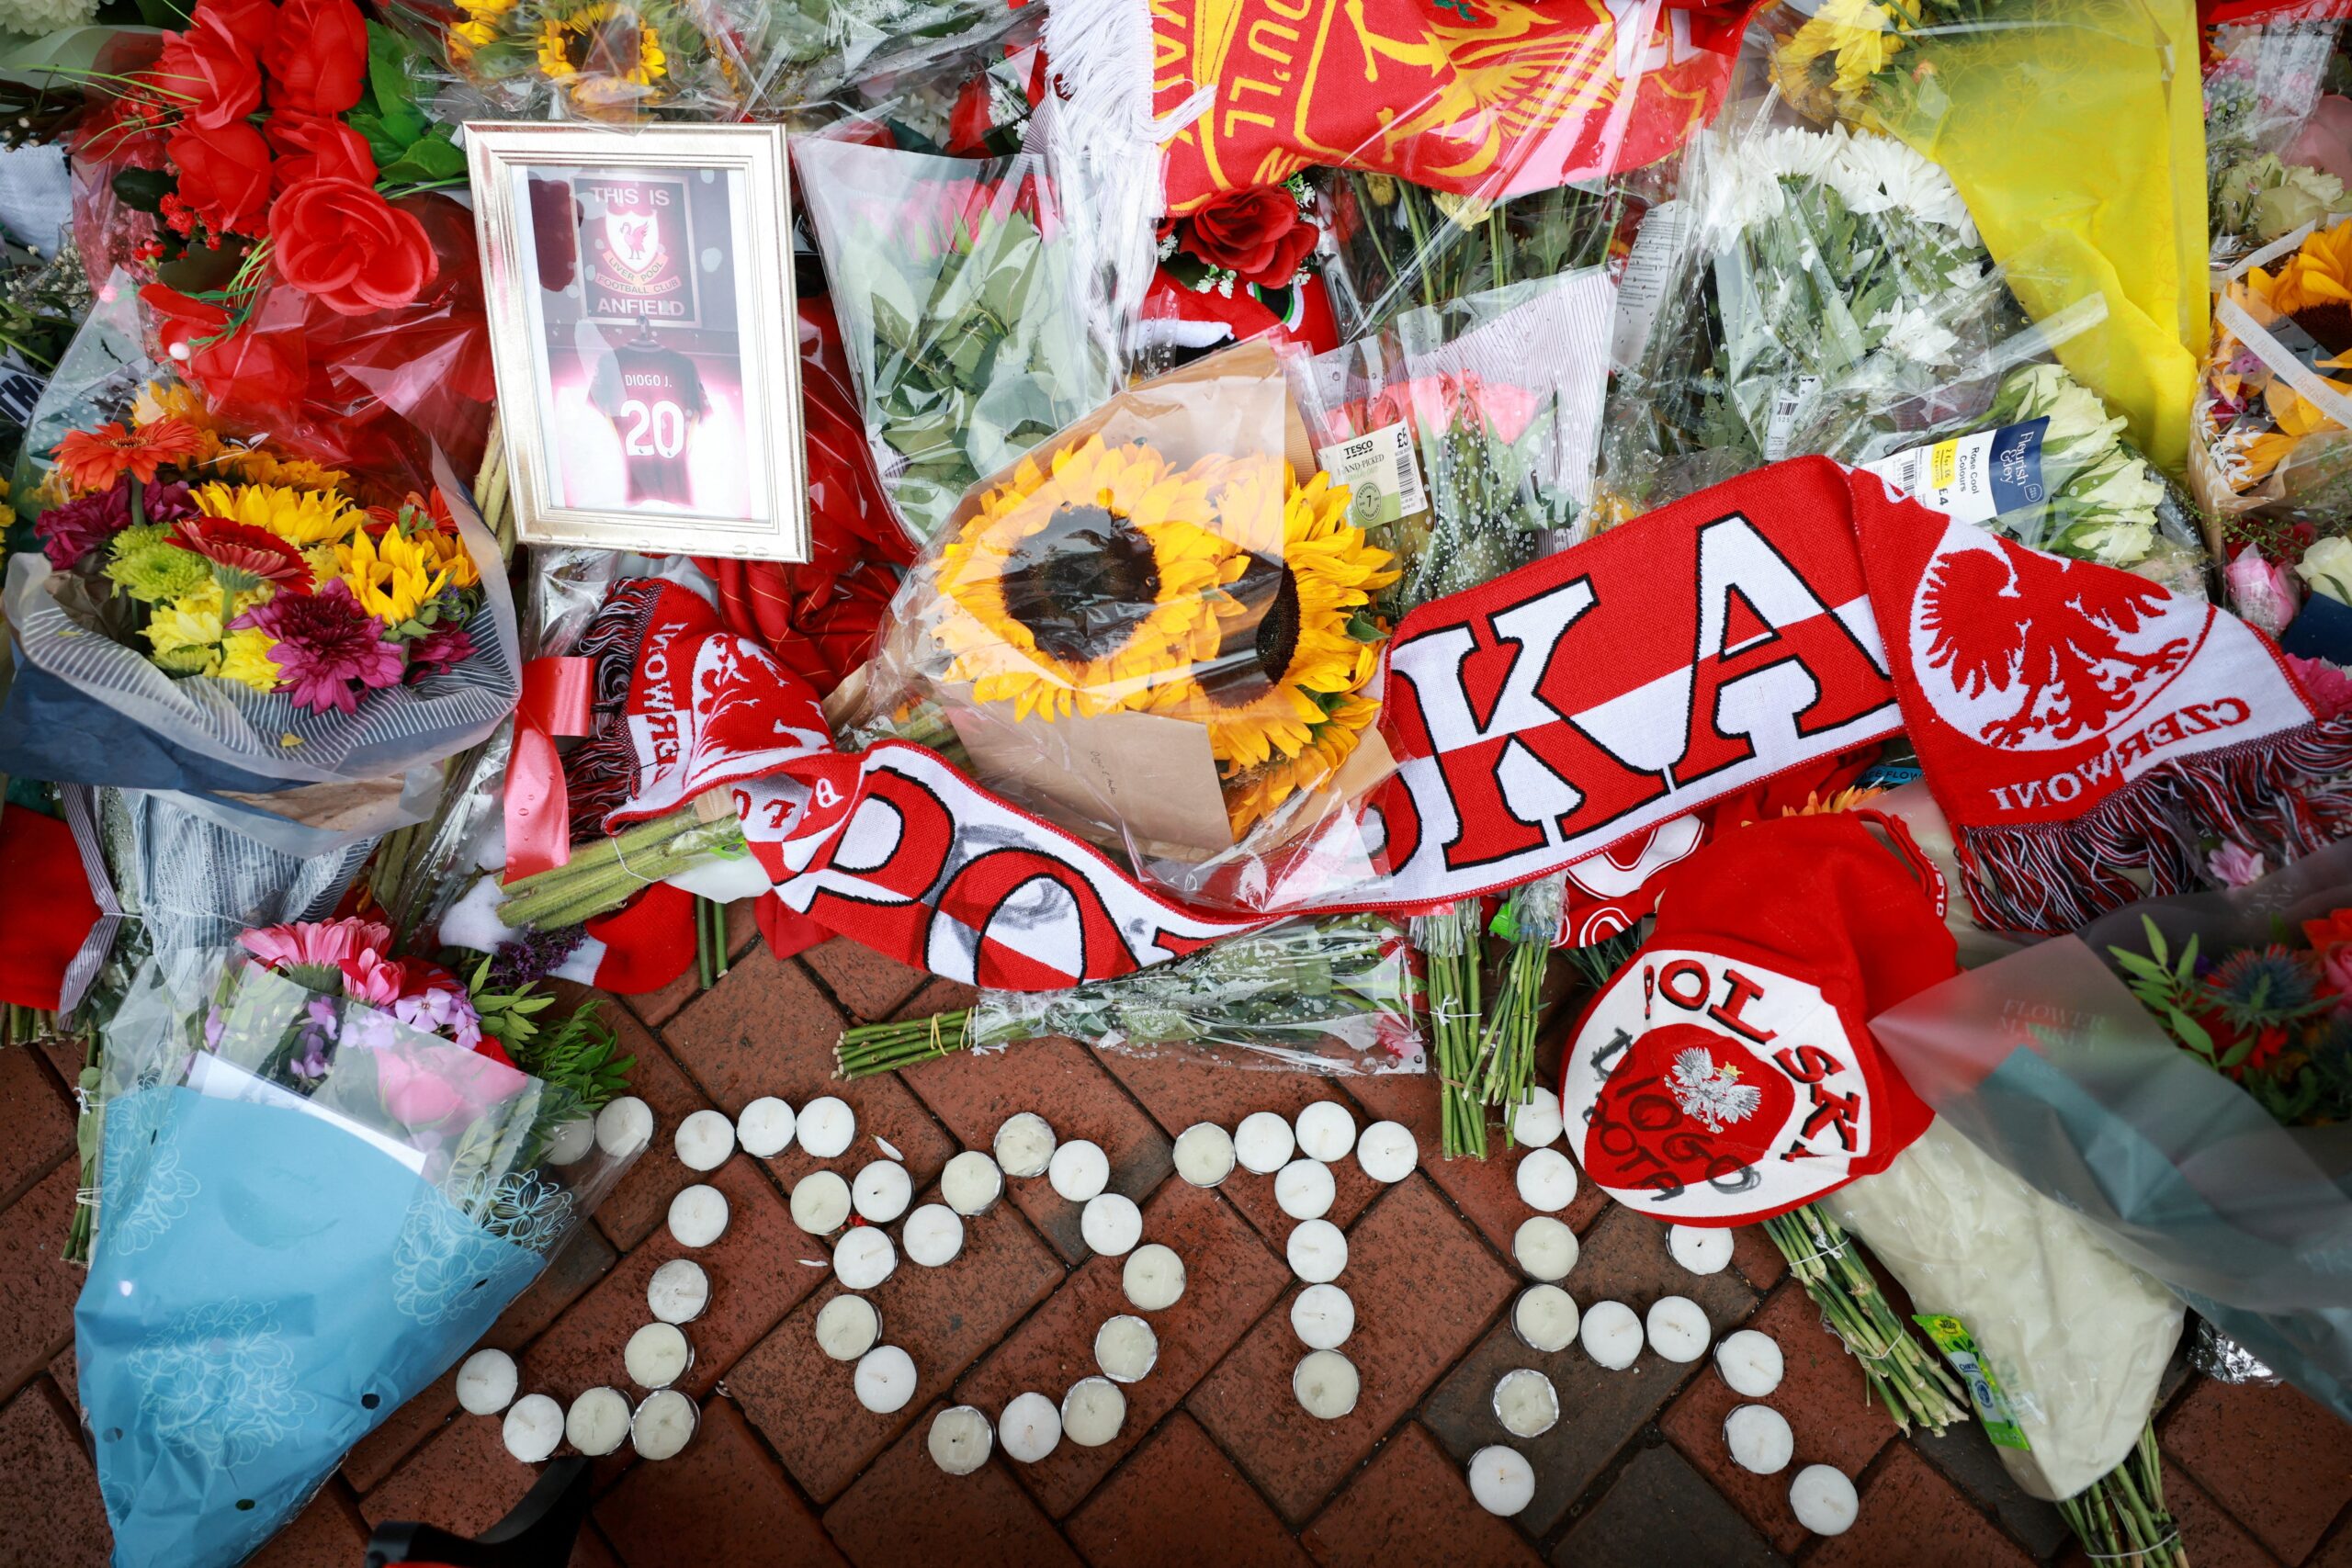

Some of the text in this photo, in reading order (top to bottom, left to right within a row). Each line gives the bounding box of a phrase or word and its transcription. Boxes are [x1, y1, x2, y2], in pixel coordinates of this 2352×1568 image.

[589, 186, 671, 207] THIS IS
[598, 275, 679, 295] FOOTBALL CLUB
[597, 298, 685, 317] ANFIELD
[625, 373, 673, 388] DIOGO J.
[620, 399, 684, 459] 20
[1396, 426, 1409, 449] £5
[1344, 440, 1374, 456] TESCO
[2015, 431, 2035, 487] Flourish
[1959, 455, 1967, 492] Colours
[1970, 446, 1980, 495] Rose Cool
[1939, 487, 1950, 506] £4
[1589, 1026, 1762, 1195] DIOGO
